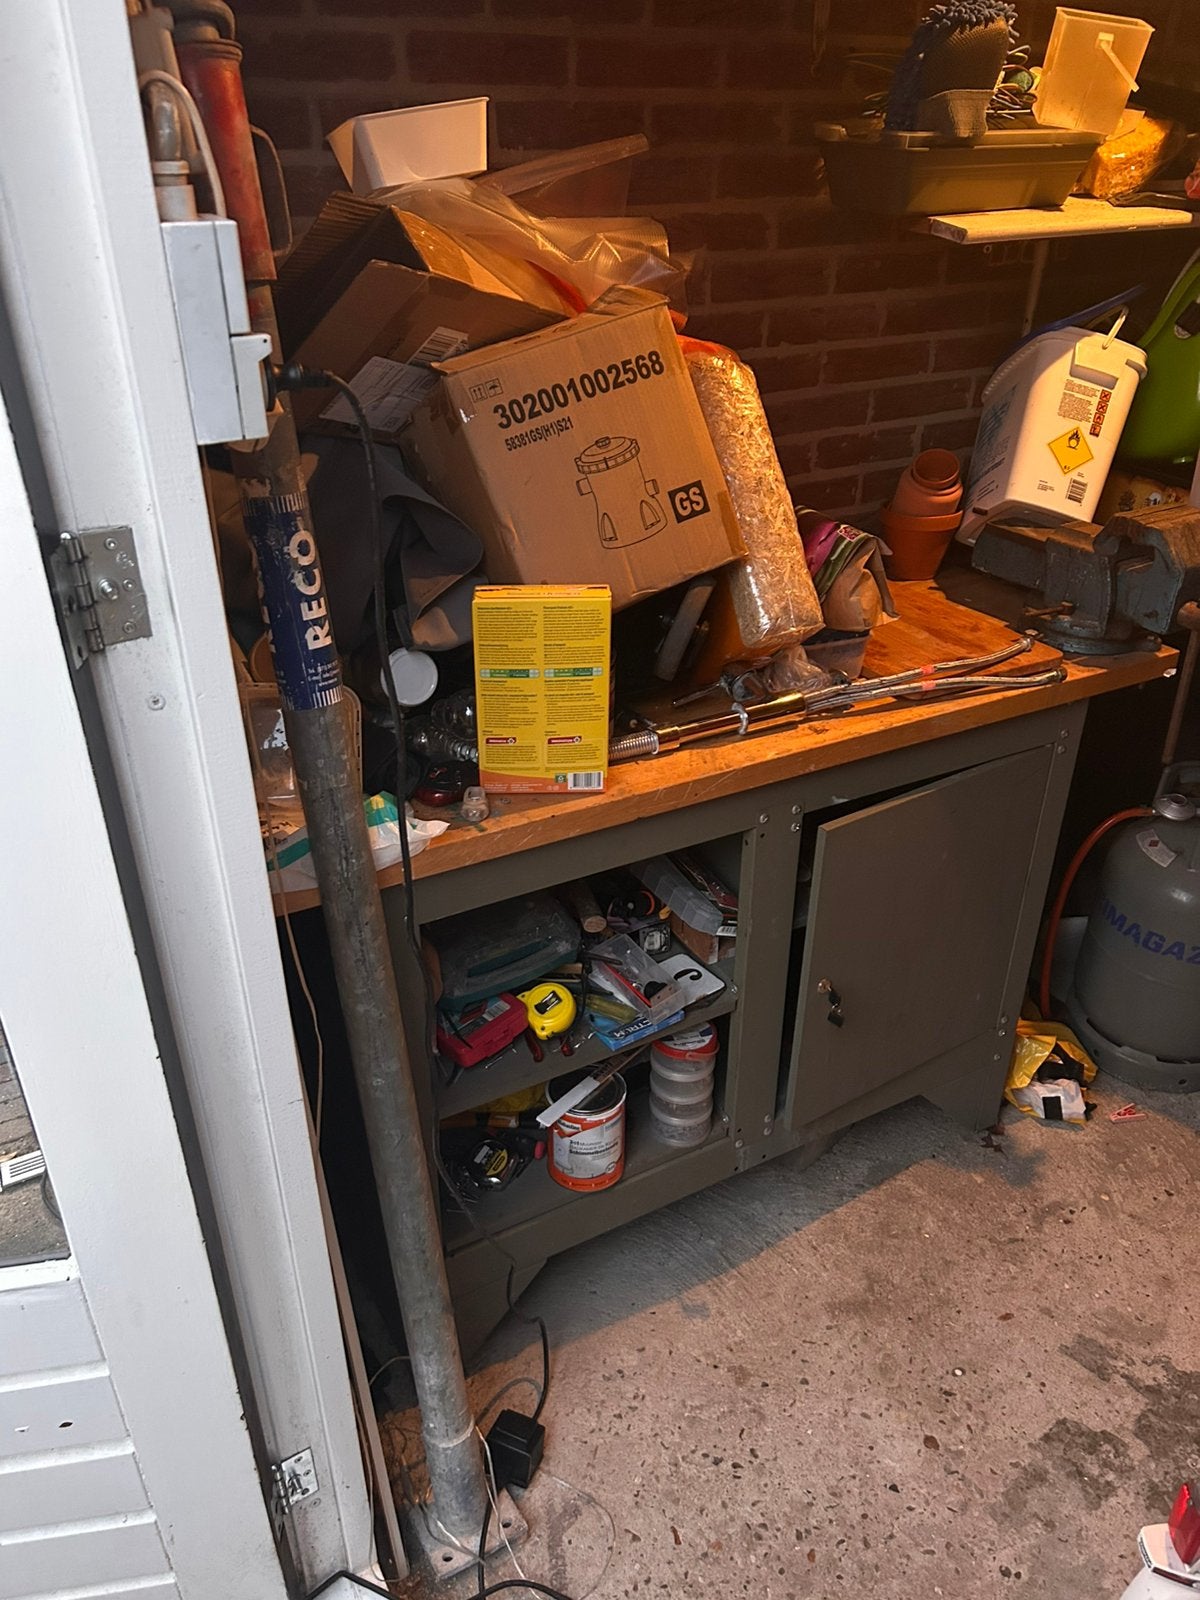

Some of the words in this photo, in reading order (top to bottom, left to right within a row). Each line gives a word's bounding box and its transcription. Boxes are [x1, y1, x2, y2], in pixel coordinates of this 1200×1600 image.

[493, 350, 665, 430] 302001002568
[504, 416, 574, 451] 58381GS(H1)S21
[674, 486, 705, 517] GS
[289, 529, 333, 651] RECO
